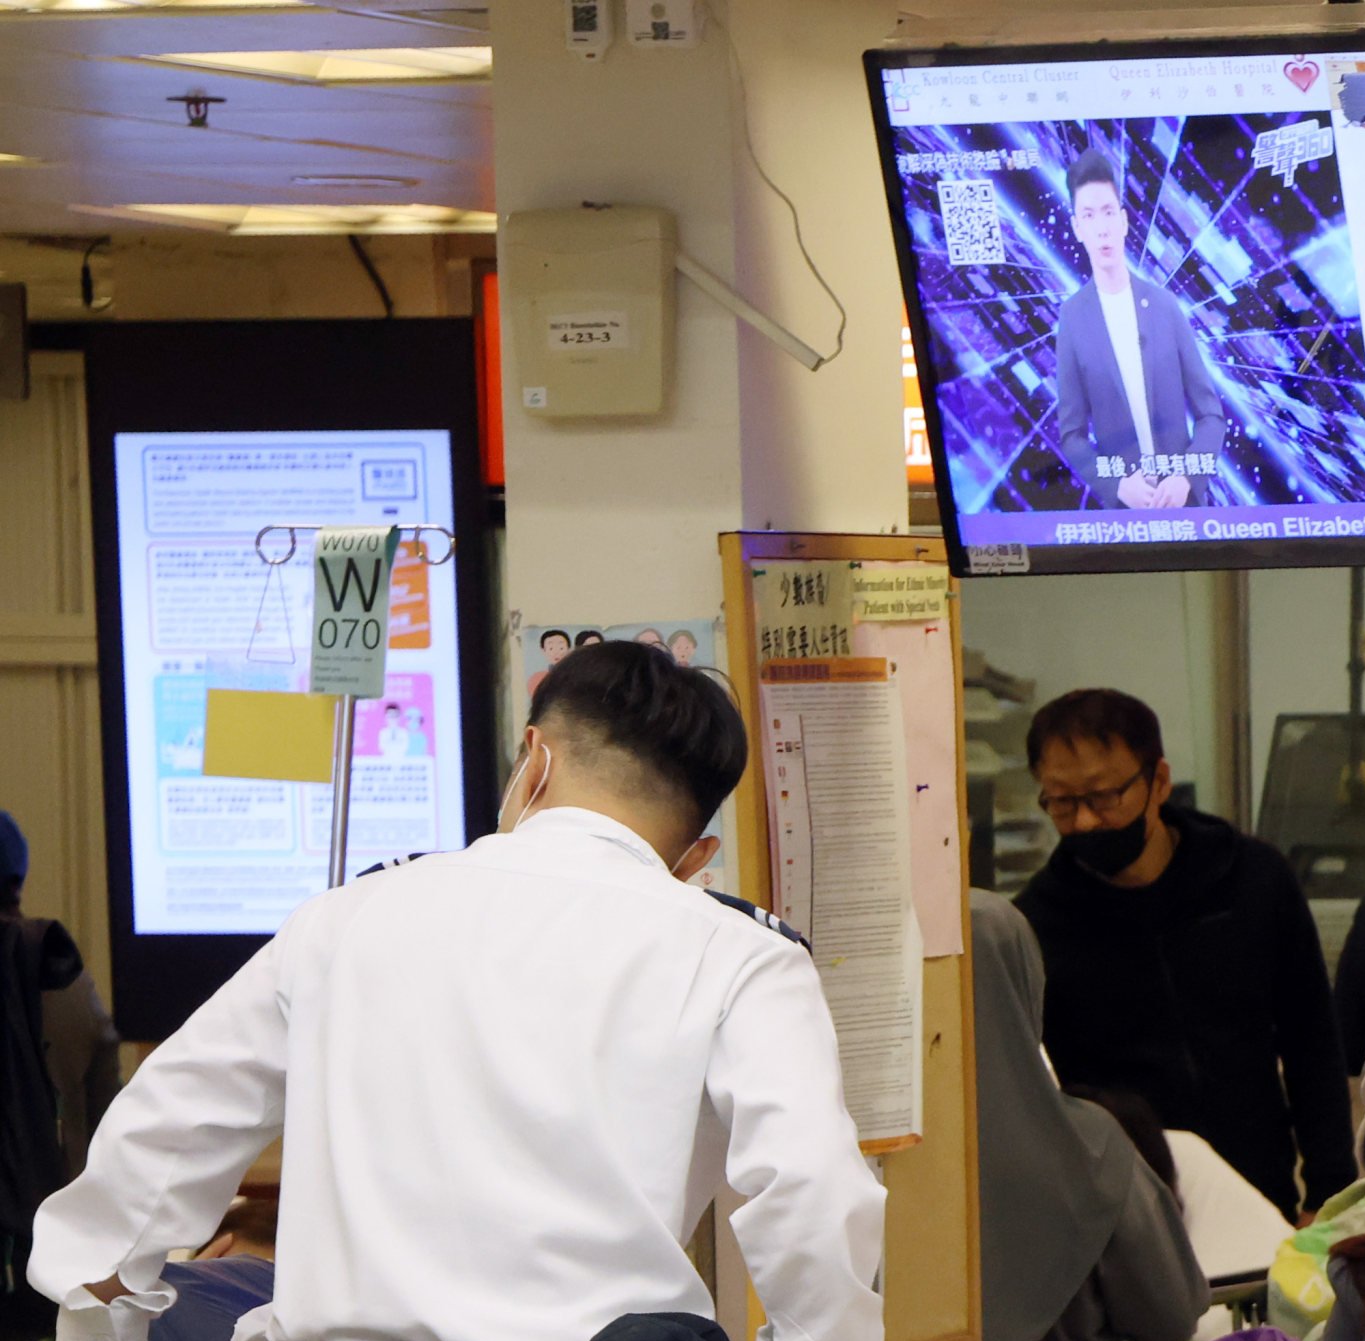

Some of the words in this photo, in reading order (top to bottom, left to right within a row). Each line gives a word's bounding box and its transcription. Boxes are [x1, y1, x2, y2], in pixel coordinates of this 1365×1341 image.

[922, 71, 978, 87] Kowloon
[982, 69, 1030, 85] Central
[1034, 68, 1080, 83] Cluster
[1109, 65, 1152, 81] Queen
[1156, 62, 1218, 78] Elizabeth
[1222, 59, 1278, 78] Hospital
[560, 331, 611, 344] 4-23-3
[1055, 519, 1198, 545] 伊利沙伯醫院
[1203, 517, 1278, 541] Queen
[322, 533, 380, 551] W070
[318, 556, 382, 613] W
[890, 600, 904, 613] with
[318, 617, 382, 650] 070
